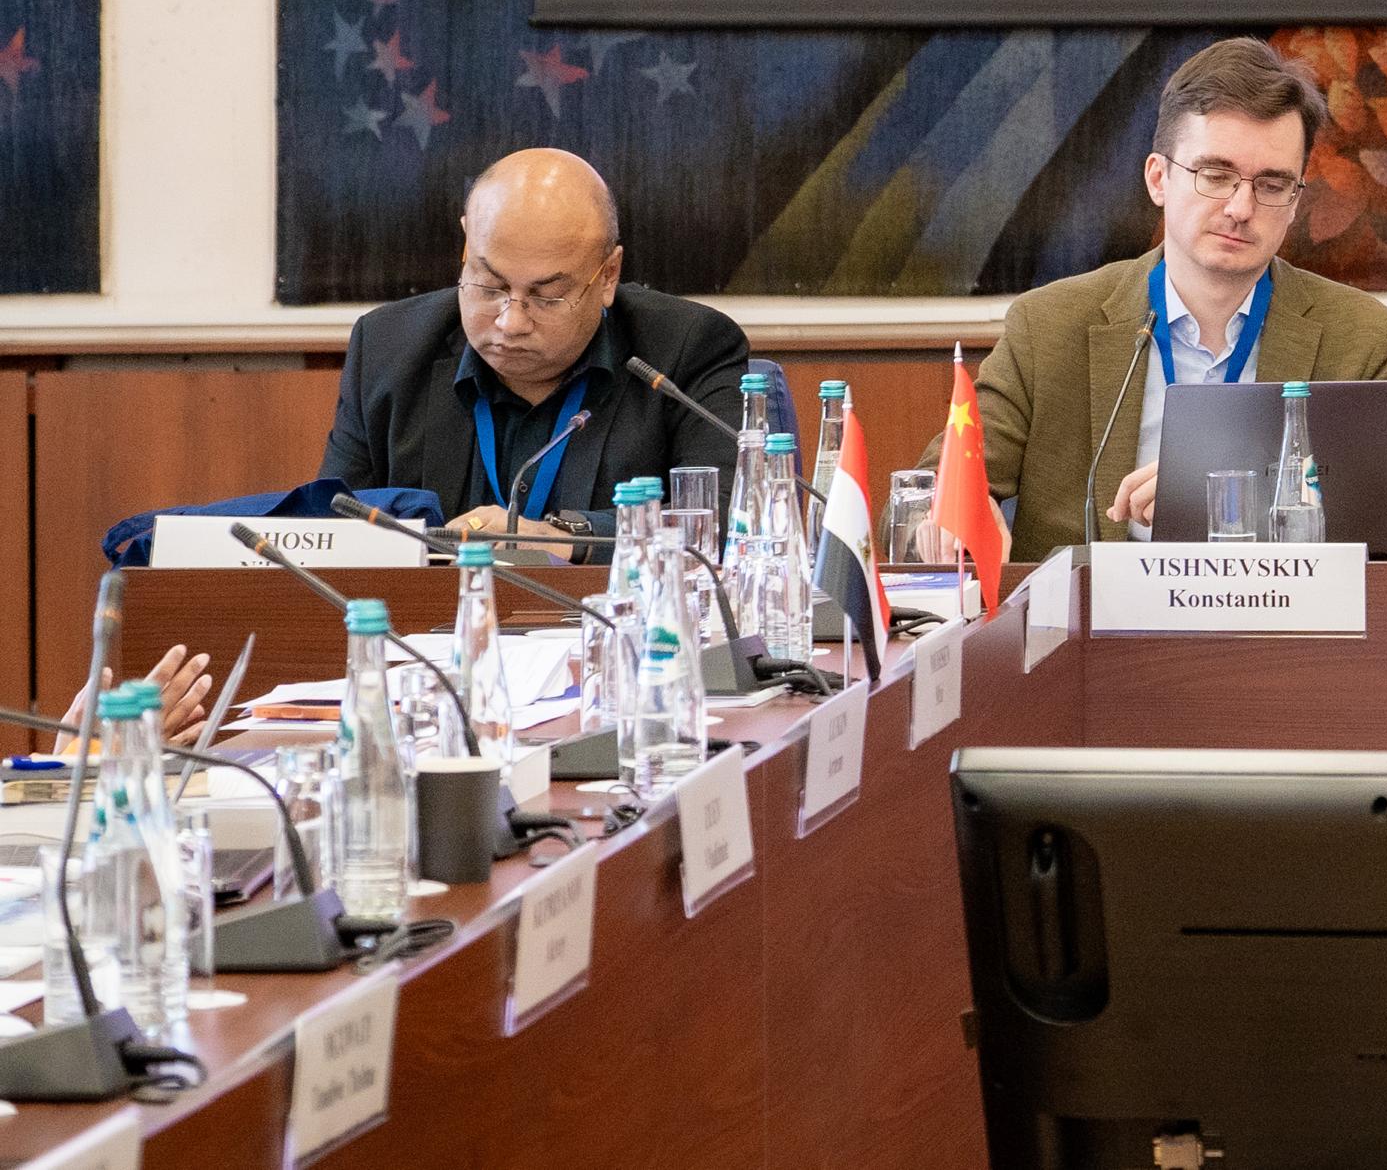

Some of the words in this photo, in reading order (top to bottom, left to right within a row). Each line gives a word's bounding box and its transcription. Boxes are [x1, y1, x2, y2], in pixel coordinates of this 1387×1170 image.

[256, 532, 334, 550] HOSH
[1139, 557, 1319, 577] VISHNEVSKIY
[1168, 588, 1291, 608] Konstantin
